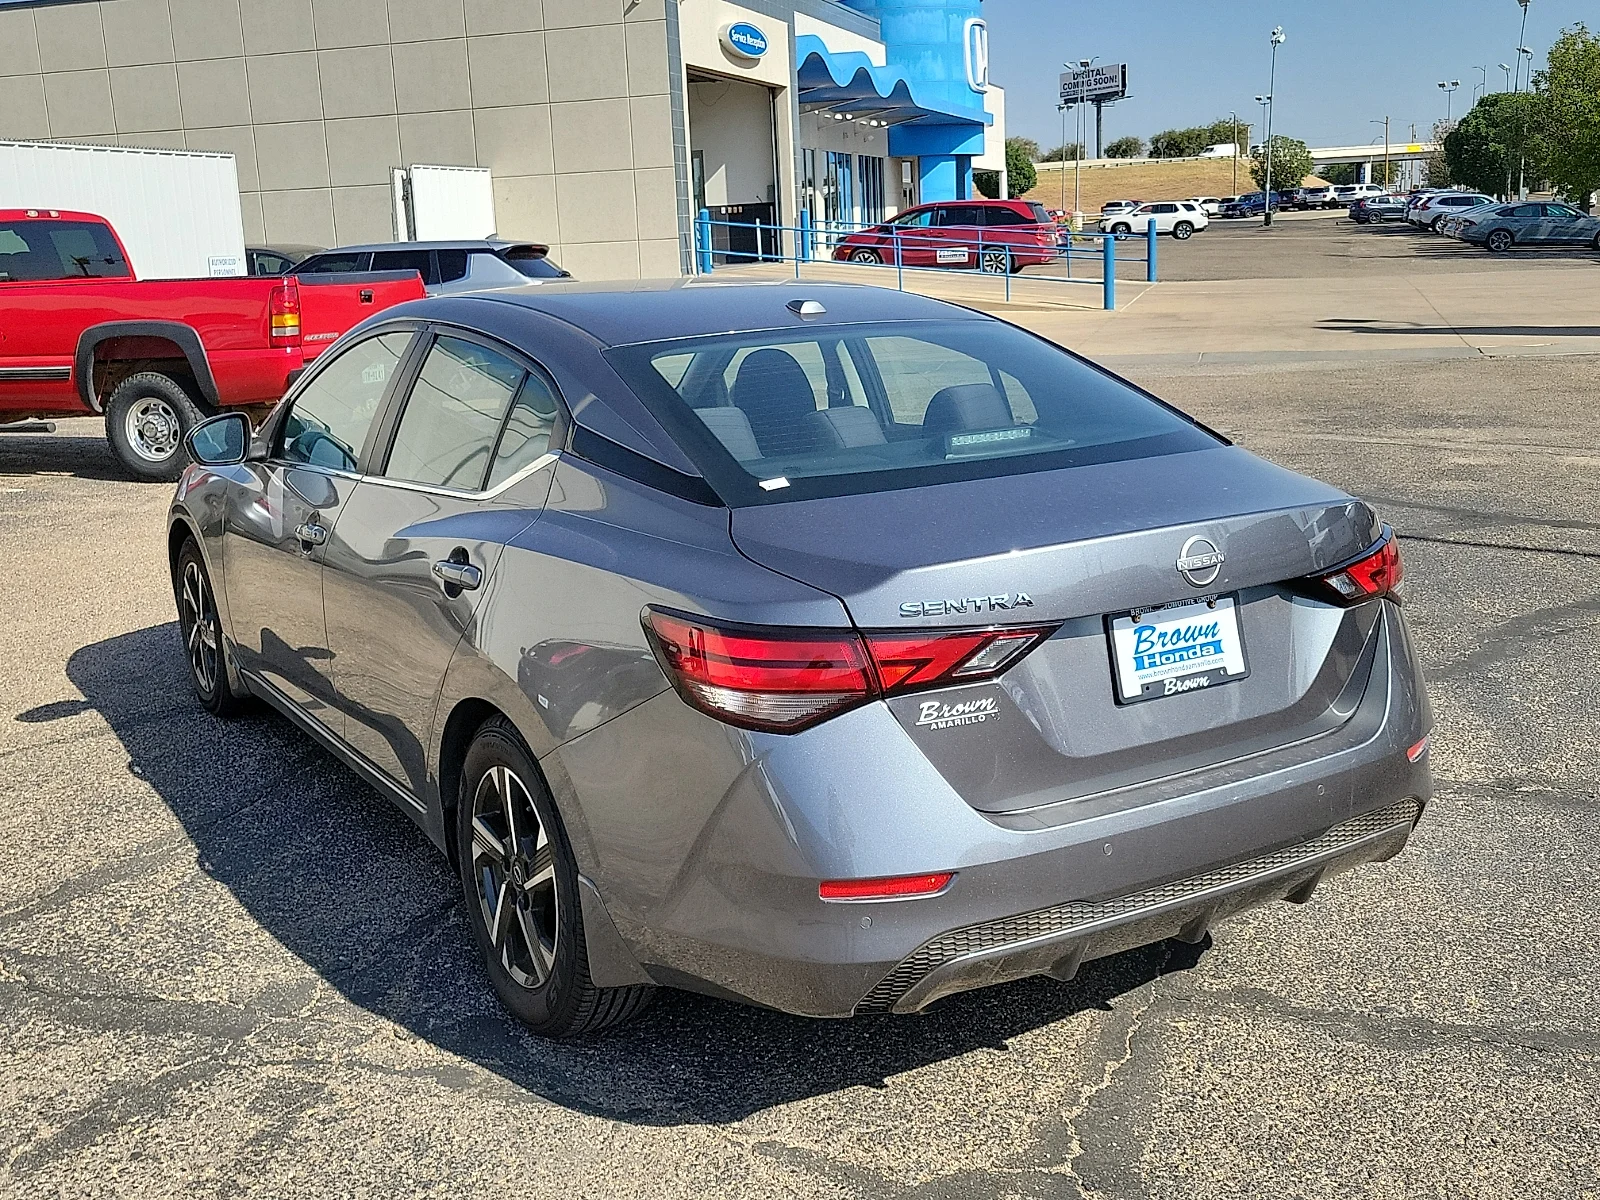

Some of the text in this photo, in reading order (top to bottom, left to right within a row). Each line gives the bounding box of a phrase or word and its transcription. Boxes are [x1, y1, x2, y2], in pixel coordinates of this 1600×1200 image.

[731, 29, 766, 49] Service Reception
[1072, 67, 1106, 80] DGITAL
[1093, 75, 1117, 86] SOON!
[1179, 553, 1225, 569] NISSAN
[899, 592, 1035, 618] SENTRA
[1196, 594, 1218, 604] GROUP
[1133, 621, 1220, 655] Brown
[1142, 644, 1216, 670] Honda
[1163, 675, 1210, 695] Brown
[918, 697, 996, 722] Brown
[930, 714, 986, 730] AMARILLO
